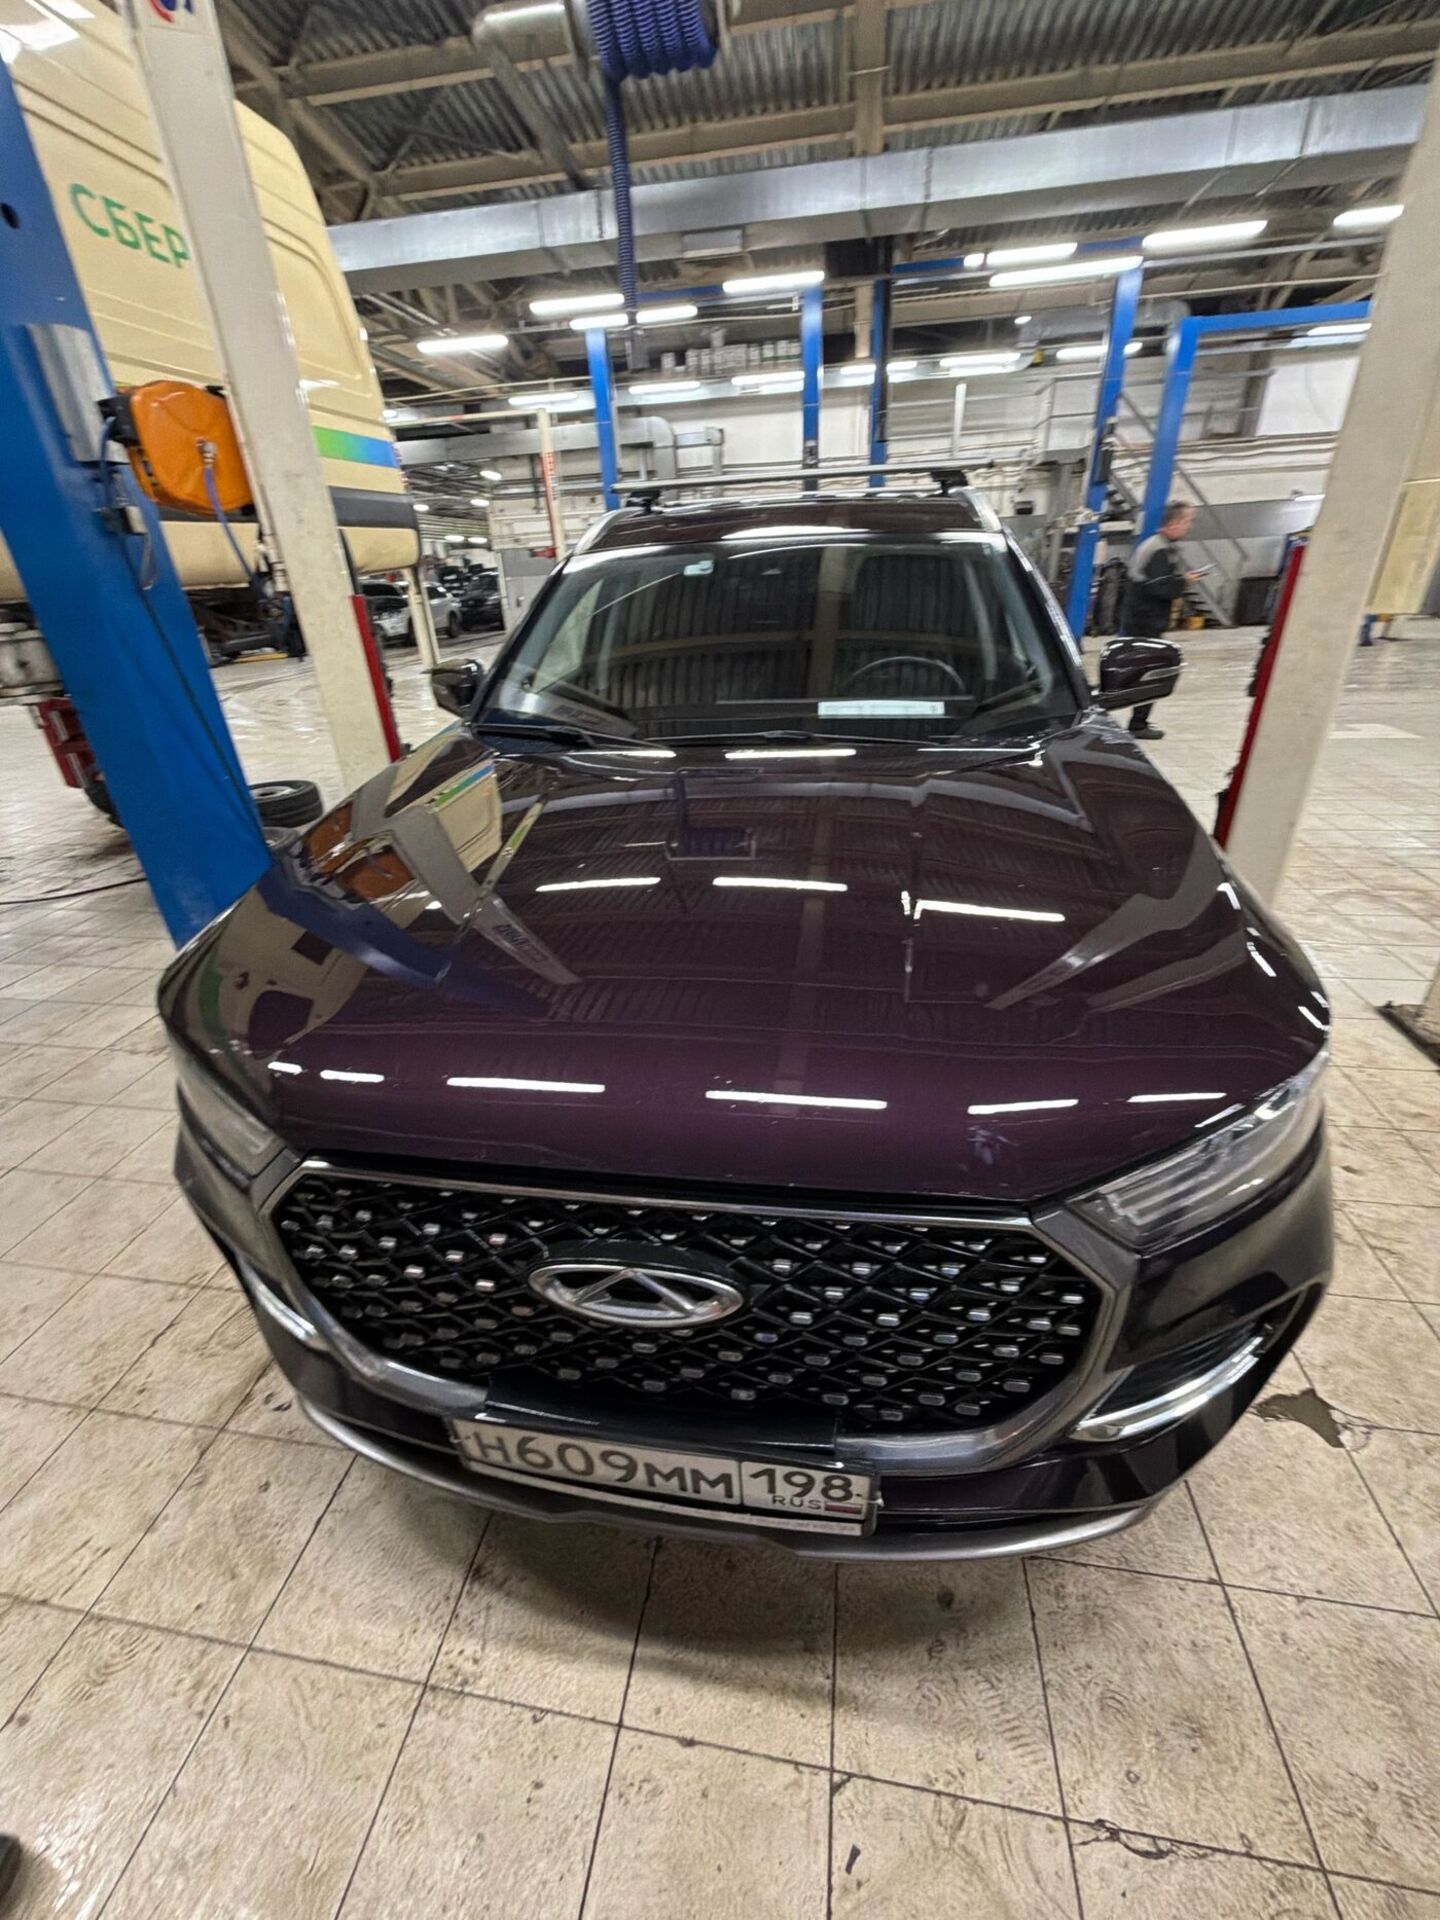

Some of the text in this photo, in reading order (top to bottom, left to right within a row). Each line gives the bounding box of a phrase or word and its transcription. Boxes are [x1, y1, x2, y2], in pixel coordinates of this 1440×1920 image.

[70, 183, 190, 268] СБЕР
[750, 1468, 853, 1502] 198
[771, 1495, 822, 1510] RUS
